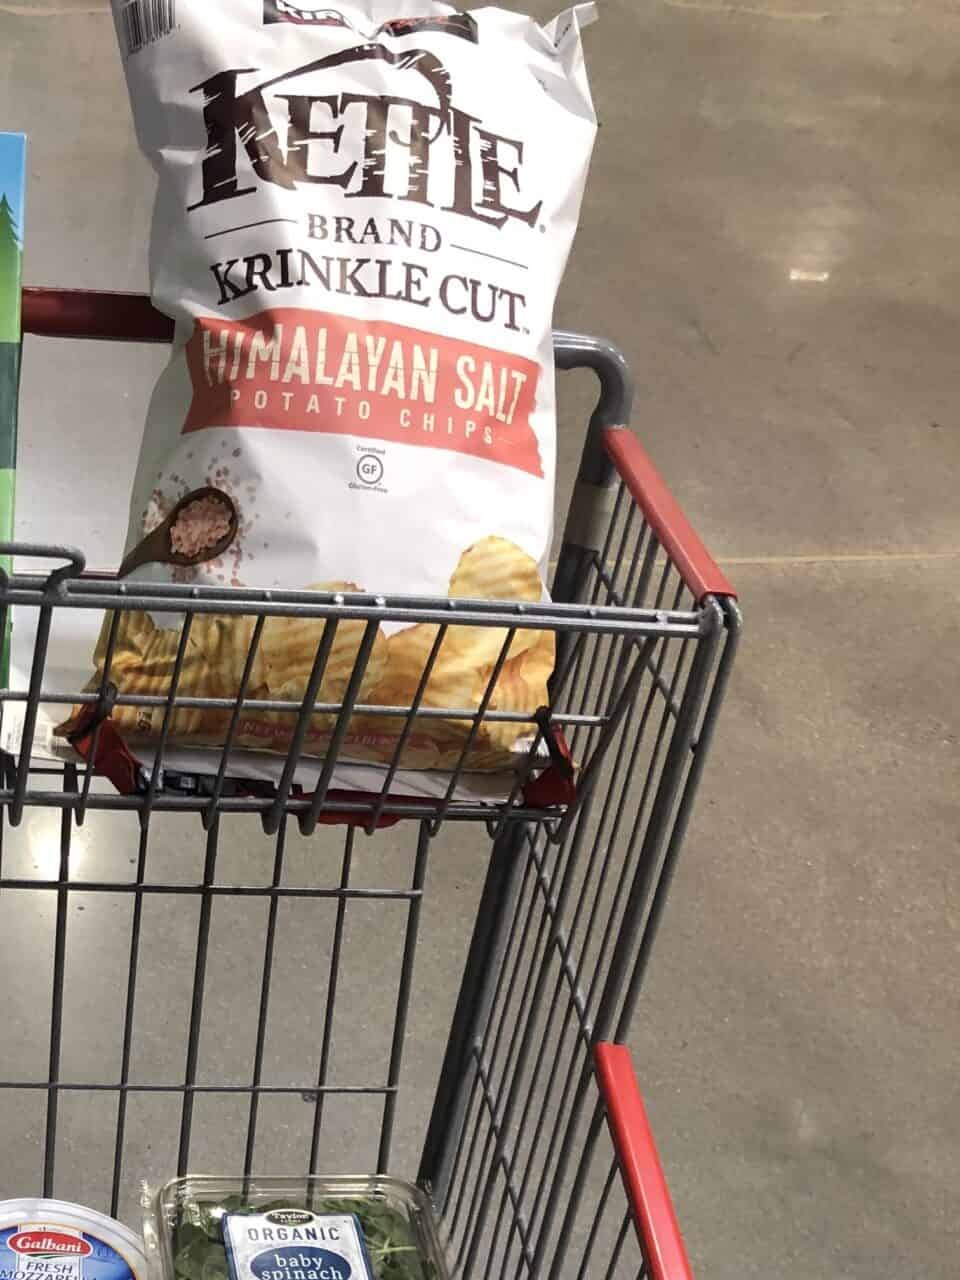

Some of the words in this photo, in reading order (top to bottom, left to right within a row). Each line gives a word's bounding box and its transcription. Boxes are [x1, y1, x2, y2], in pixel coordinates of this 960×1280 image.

[187, 43, 543, 230] KETTLE
[307, 213, 442, 253] BRAND
[210, 249, 431, 306] KRINKLE
[440, 275, 527, 331] CUT
[201, 325, 439, 403] HIMALAYAN
[455, 356, 528, 425] SALT
[231, 389, 372, 420] POTATO
[400, 408, 494, 445] CHIPS
[362, 464, 377, 474] GF
[16, 1235, 82, 1254] Galbani
[248, 1227, 339, 1241] ORGANIC
[26, 1261, 73, 1274] FRESH
[274, 1254, 323, 1270] baby
